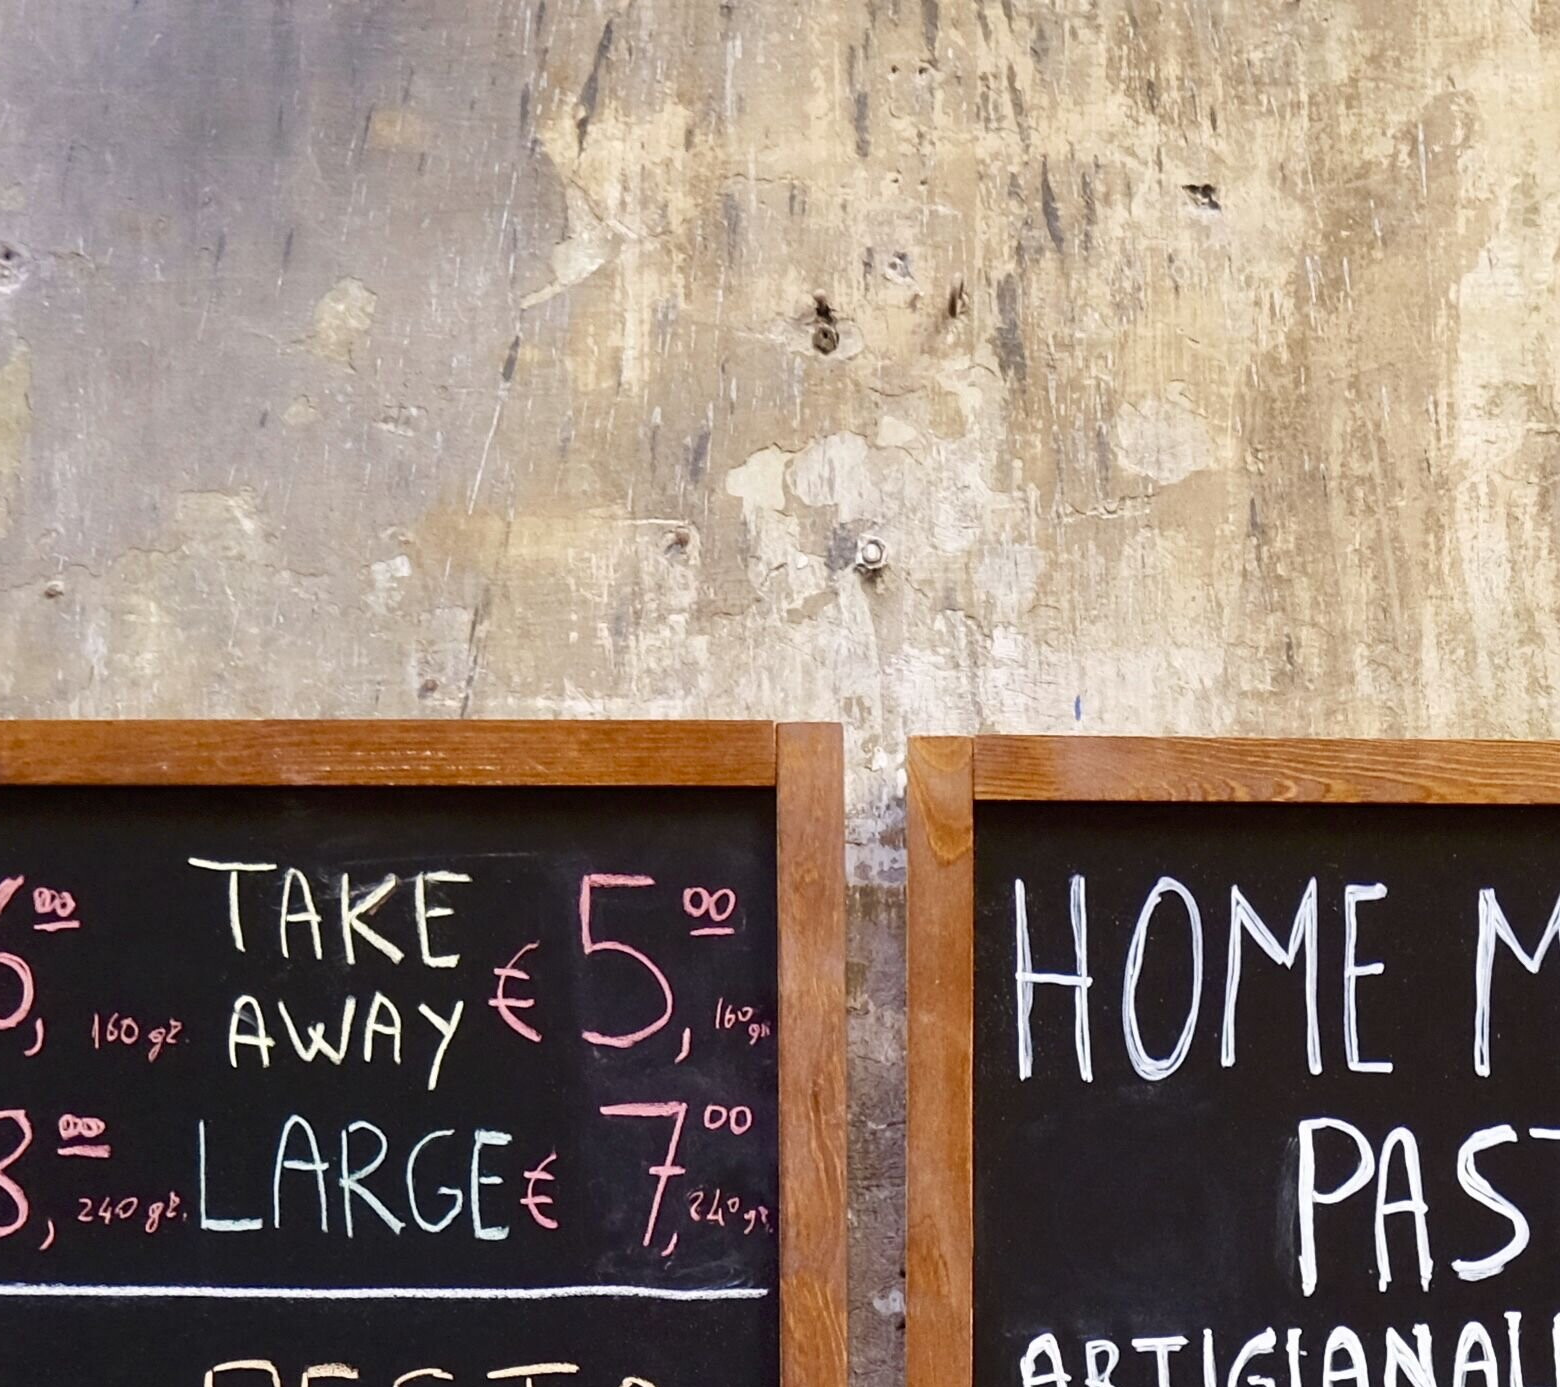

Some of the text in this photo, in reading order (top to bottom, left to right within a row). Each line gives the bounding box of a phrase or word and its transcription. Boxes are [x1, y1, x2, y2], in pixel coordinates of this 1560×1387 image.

[188, 857, 471, 968] TAKE
[488, 943, 541, 1042] €
[1015, 874, 1393, 1082] HOME
[229, 991, 464, 1090] AWAY
[199, 1115, 512, 1240] LARGE
[520, 1153, 558, 1229] €
